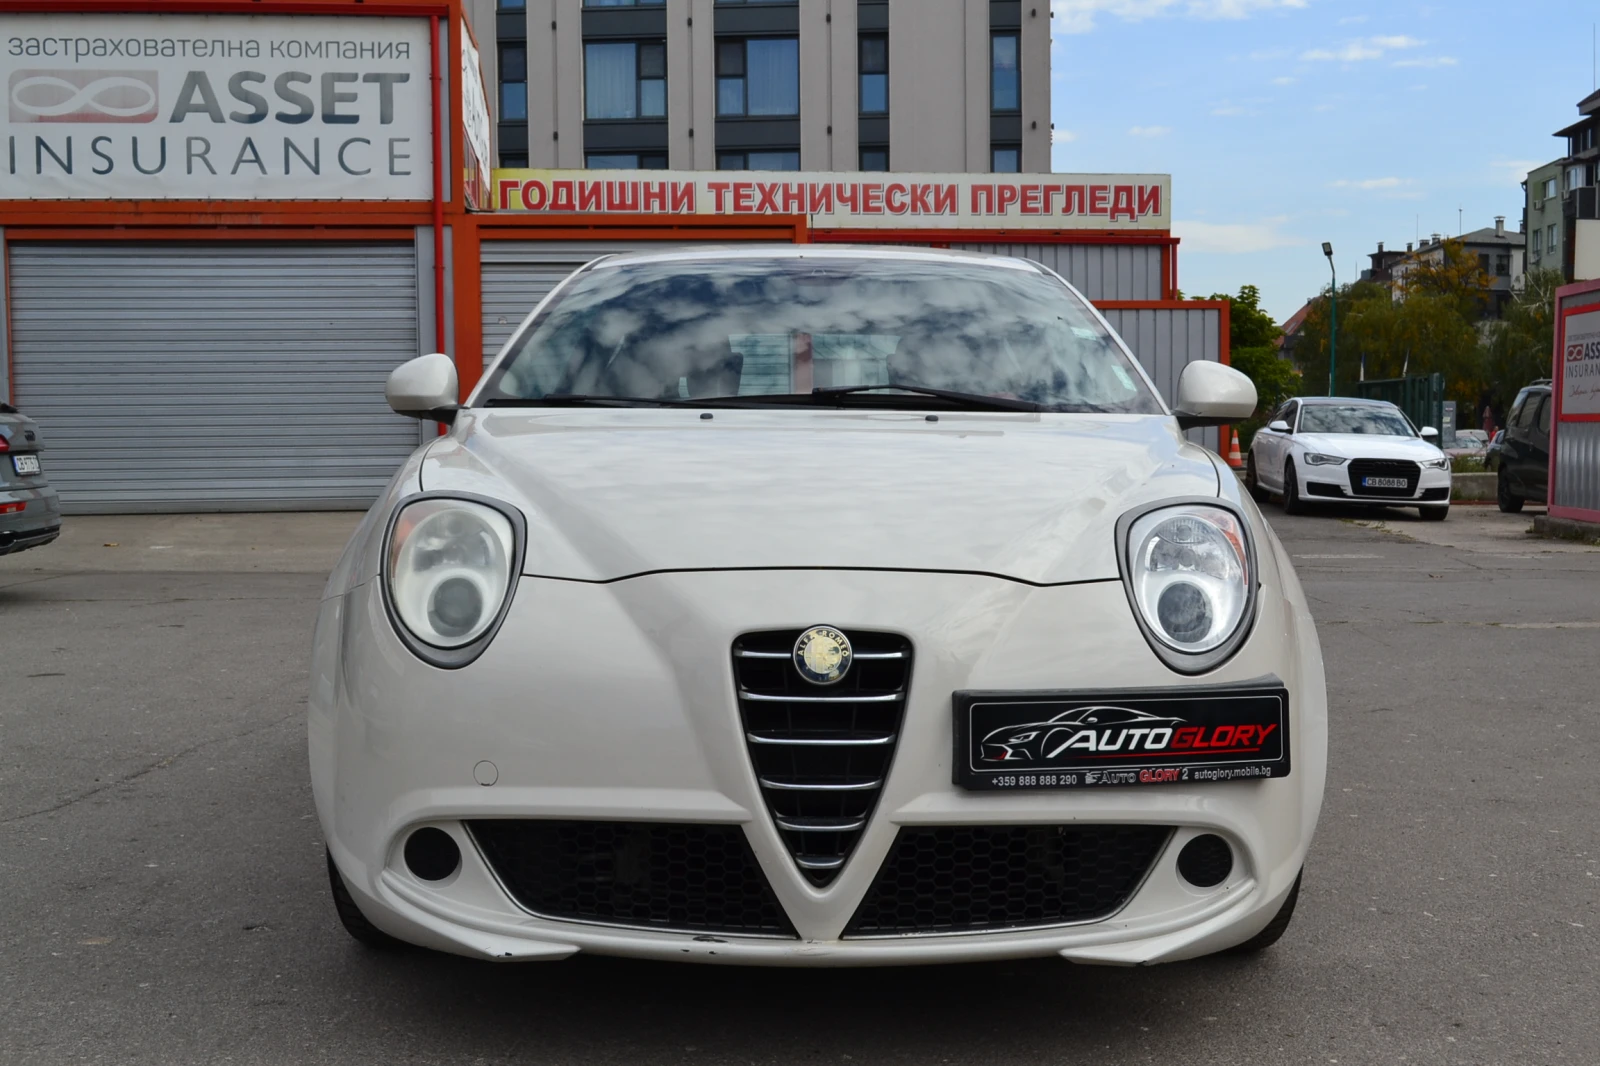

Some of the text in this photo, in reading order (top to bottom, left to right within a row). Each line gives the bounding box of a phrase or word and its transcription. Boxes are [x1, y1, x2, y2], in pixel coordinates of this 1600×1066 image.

[8, 36, 411, 63] застрахователна компания
[169, 70, 411, 125] ASSET
[8, 135, 412, 176] INSURANCE
[498, 179, 1163, 222] ГОДИШНИ ТЕХНИЧЕСКИ ПРЕГЛЕДИ
[822, 629, 850, 657] ROMEO
[991, 776, 1016, 786] +359
[1018, 775, 1037, 786] 888
[1039, 774, 1057, 785] 888
[1059, 774, 1078, 785] 290
[1139, 767, 1181, 783] GLORY
[1194, 765, 1271, 781] autoglory.mobile.bg
